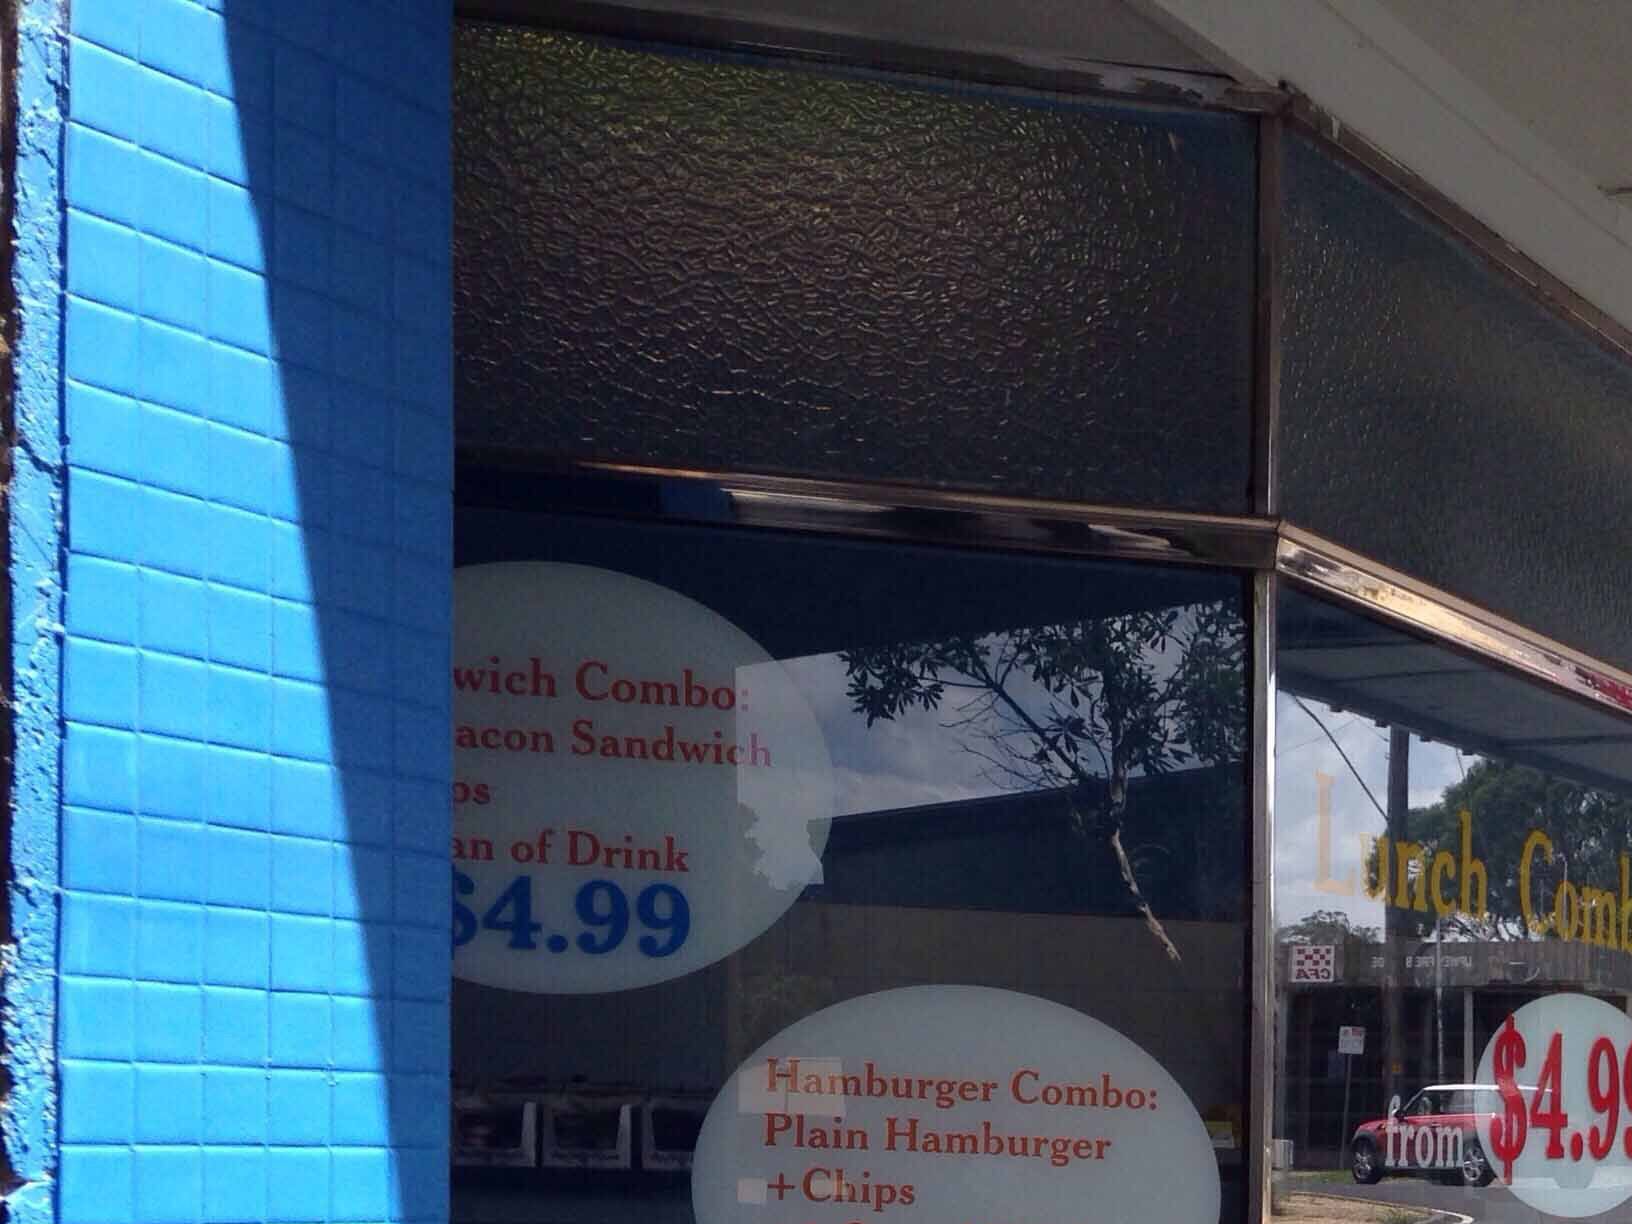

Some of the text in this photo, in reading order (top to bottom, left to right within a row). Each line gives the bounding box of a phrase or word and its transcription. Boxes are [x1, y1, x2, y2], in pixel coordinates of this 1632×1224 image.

[453, 655, 749, 711] wich Combo:
[455, 719, 771, 768] acon Sandwich
[452, 828, 690, 873] an of Drink
[1312, 767, 1488, 922] Lunch
[766, 1057, 1158, 1112] Hamburger Combo:
[763, 1113, 1113, 1166] Plain Hamburger
[1384, 1095, 1465, 1169] from
